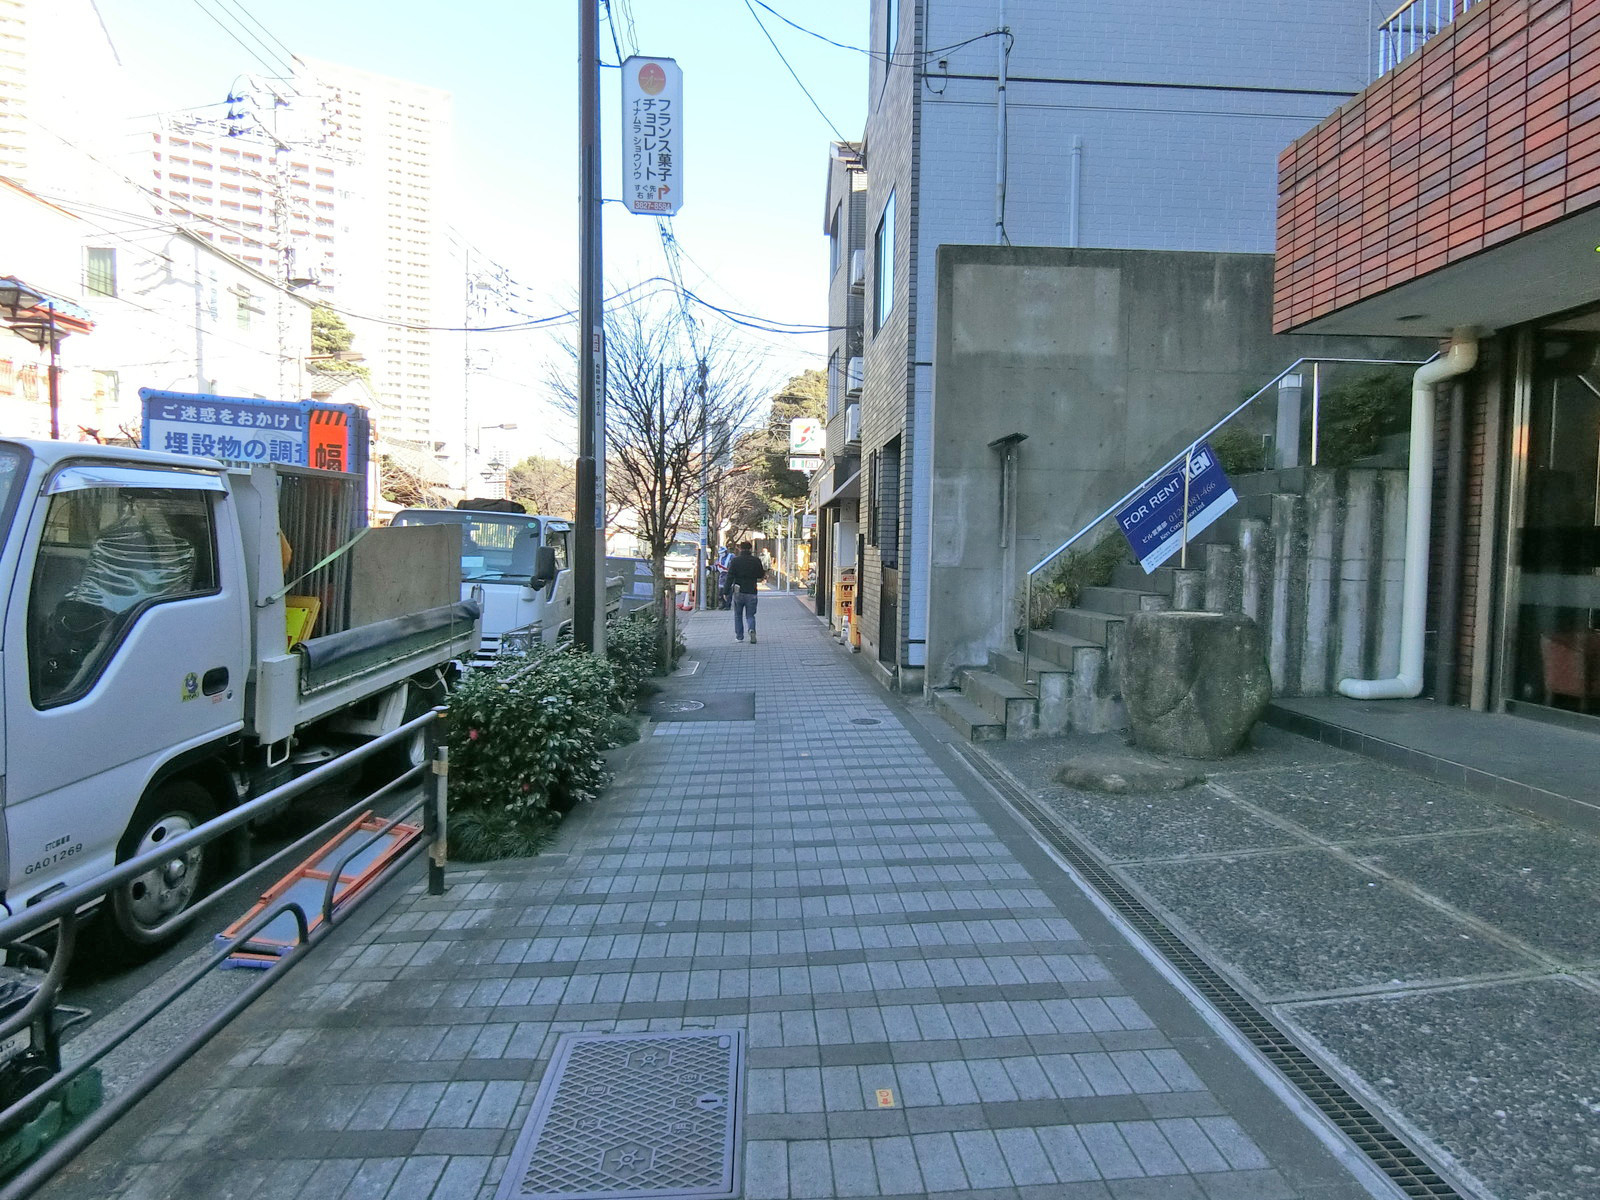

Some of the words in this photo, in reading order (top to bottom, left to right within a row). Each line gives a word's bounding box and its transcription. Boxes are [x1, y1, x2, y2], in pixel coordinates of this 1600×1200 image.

[633, 98, 641, 134] イナムラ
[643, 98, 656, 181] チョコレート
[657, 99, 672, 182] フランス菓子
[634, 184, 656, 192] すぐ先
[637, 192, 654, 200] 右折
[1122, 504, 1149, 530] FOR
[1149, 478, 1180, 508] RENT
